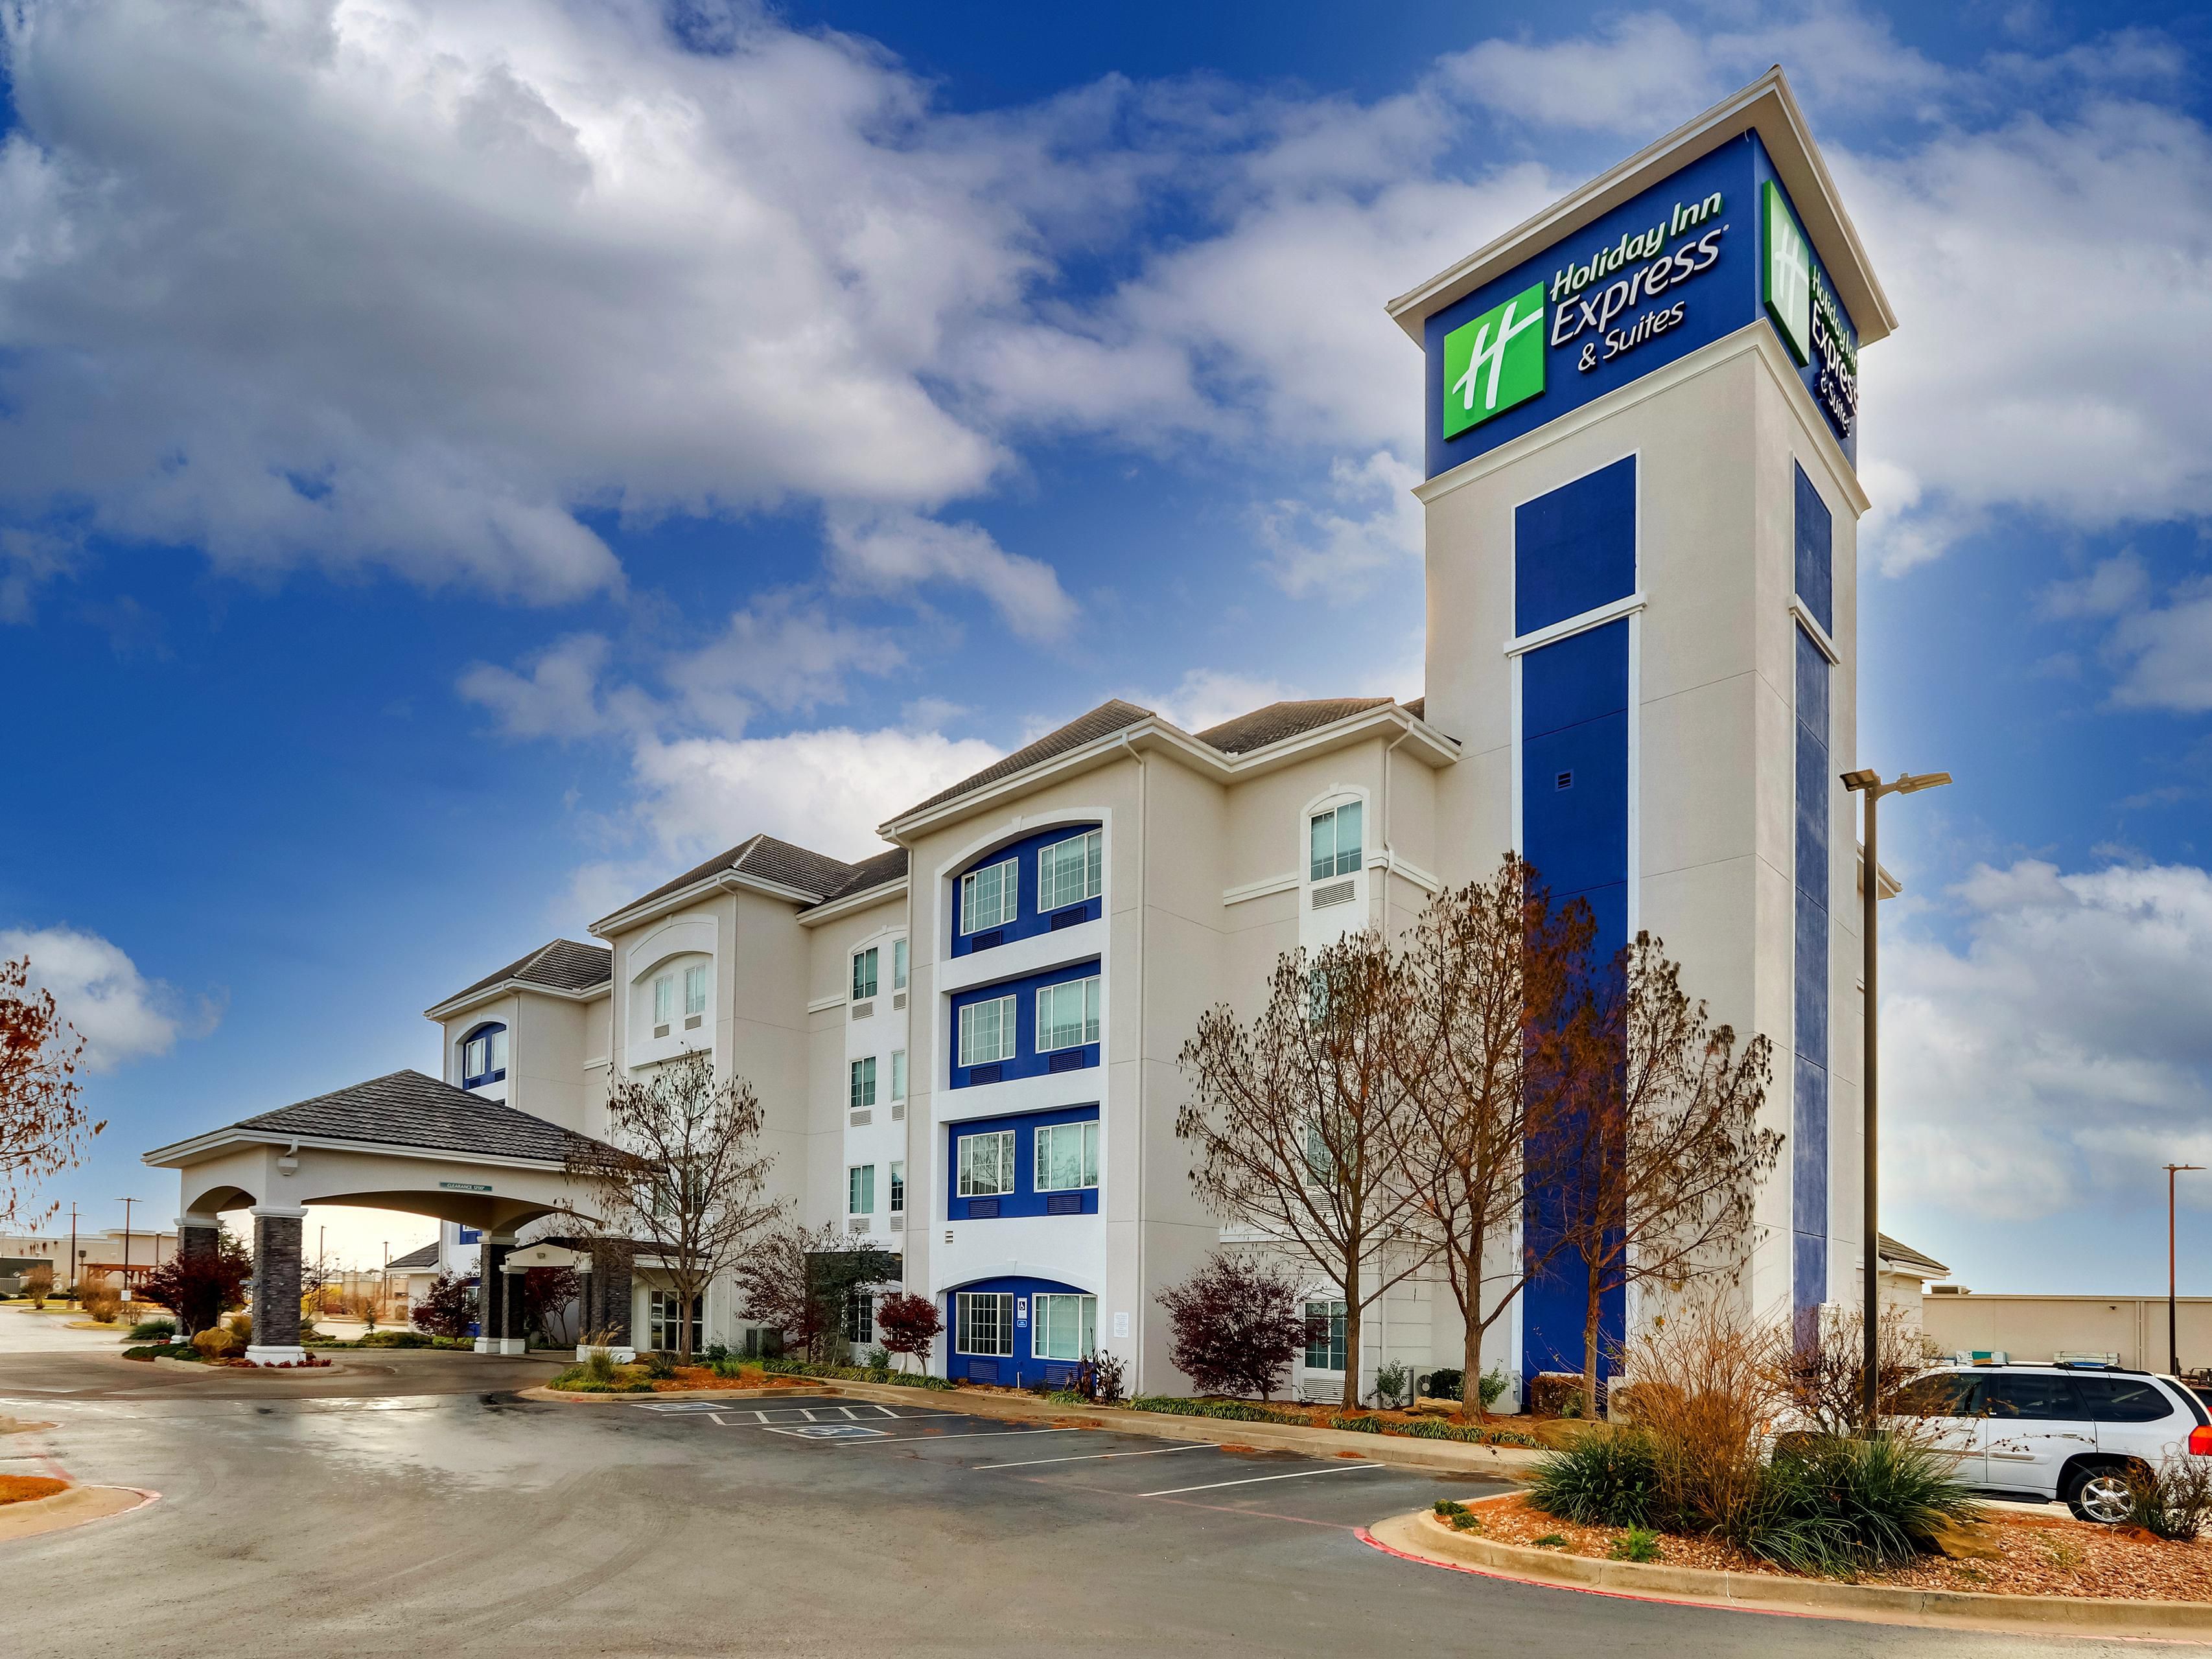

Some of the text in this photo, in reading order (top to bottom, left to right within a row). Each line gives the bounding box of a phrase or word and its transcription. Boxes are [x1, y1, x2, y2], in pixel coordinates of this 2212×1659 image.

[1550, 192, 1722, 302] Holiday Inn
[1551, 228, 1722, 347] Express
[1577, 300, 1685, 371] & Suites
[1812, 265, 1846, 353] Holiday
[1828, 381, 1851, 437] Suites
